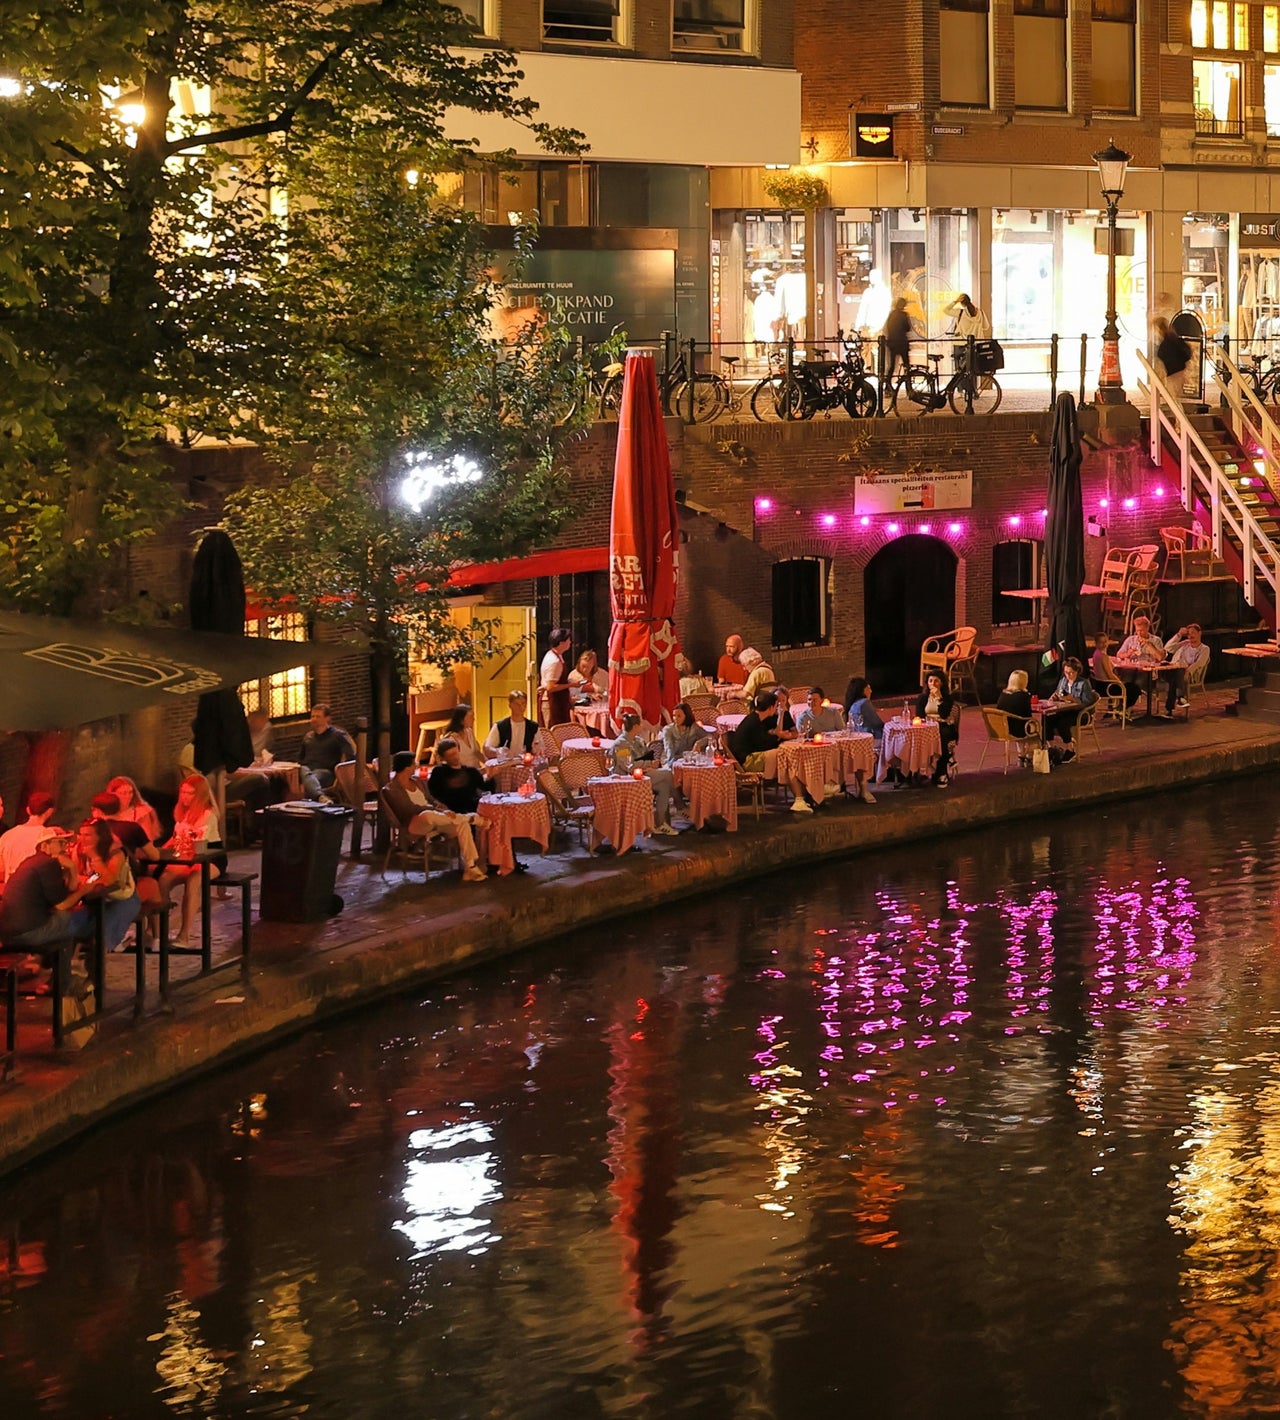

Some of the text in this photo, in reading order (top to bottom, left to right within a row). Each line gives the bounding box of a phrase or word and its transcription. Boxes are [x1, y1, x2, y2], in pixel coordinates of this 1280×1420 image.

[1242, 224, 1275, 235] JUST
[935, 473, 968, 481] restaurant
[902, 484, 928, 492] pizzeria
